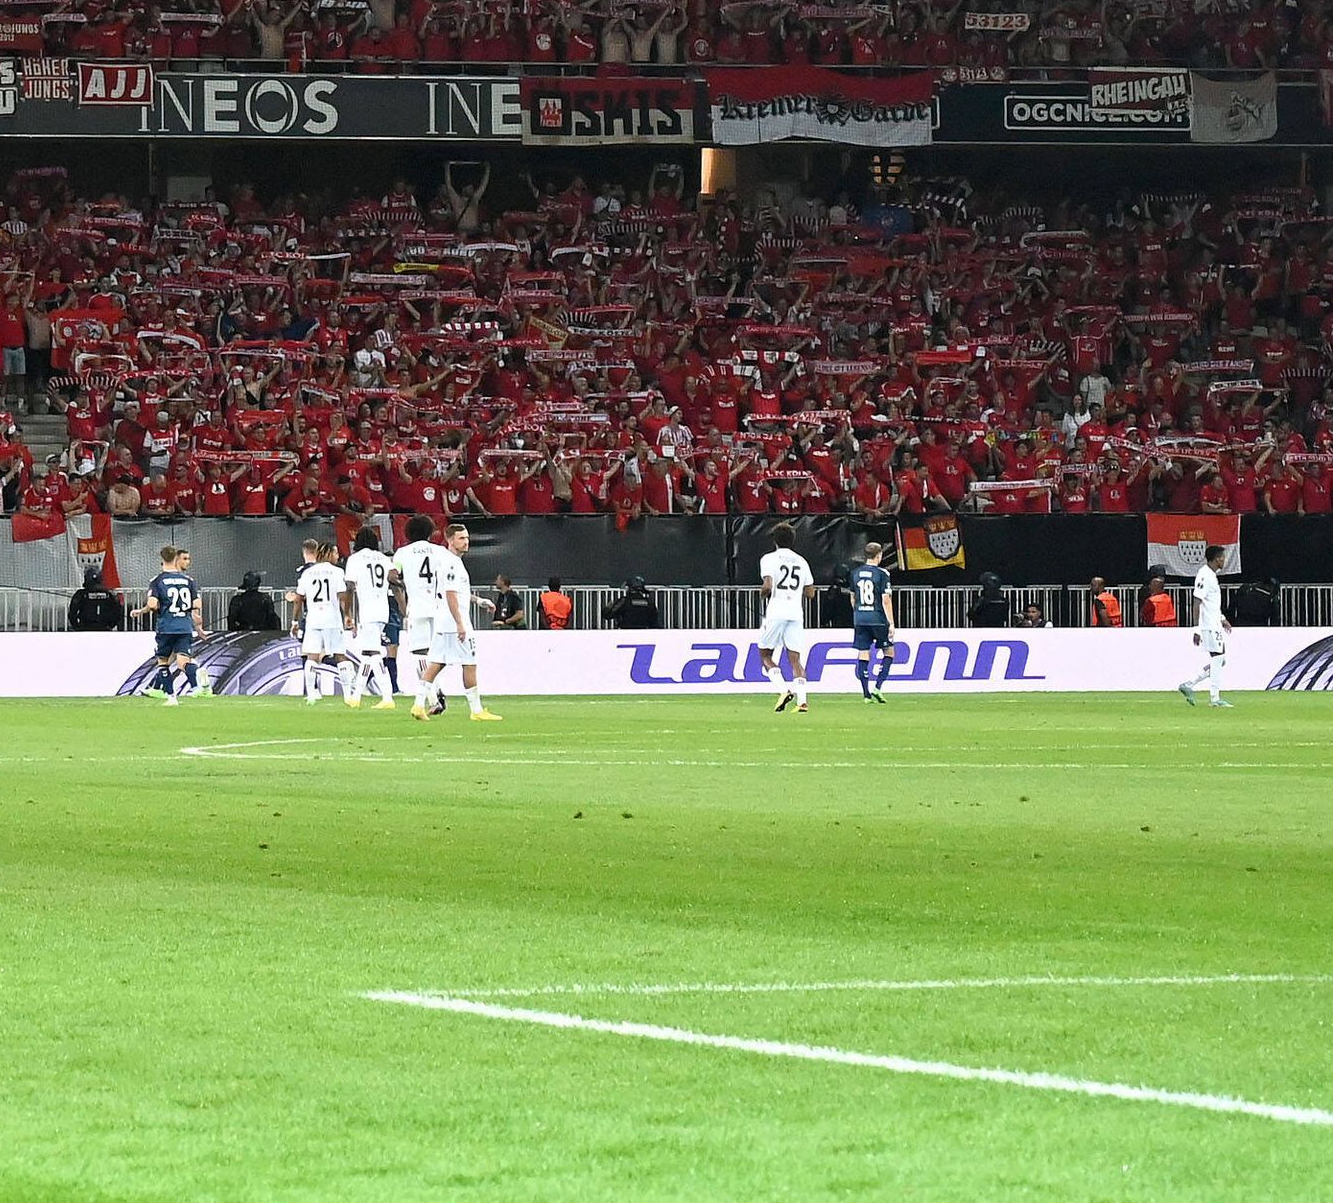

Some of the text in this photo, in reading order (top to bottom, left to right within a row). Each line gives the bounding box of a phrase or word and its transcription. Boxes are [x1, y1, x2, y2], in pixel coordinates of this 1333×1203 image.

[967, 13, 1027, 29] 53123
[24, 79, 70, 101] JUNGS
[84, 68, 150, 99] AJJ
[425, 81, 522, 135] INE
[366, 563, 385, 588] 19
[419, 556, 433, 584] 4
[776, 565, 802, 590] 25
[167, 586, 192, 613] 29
[312, 578, 331, 603] 21
[856, 579, 876, 604] 18
